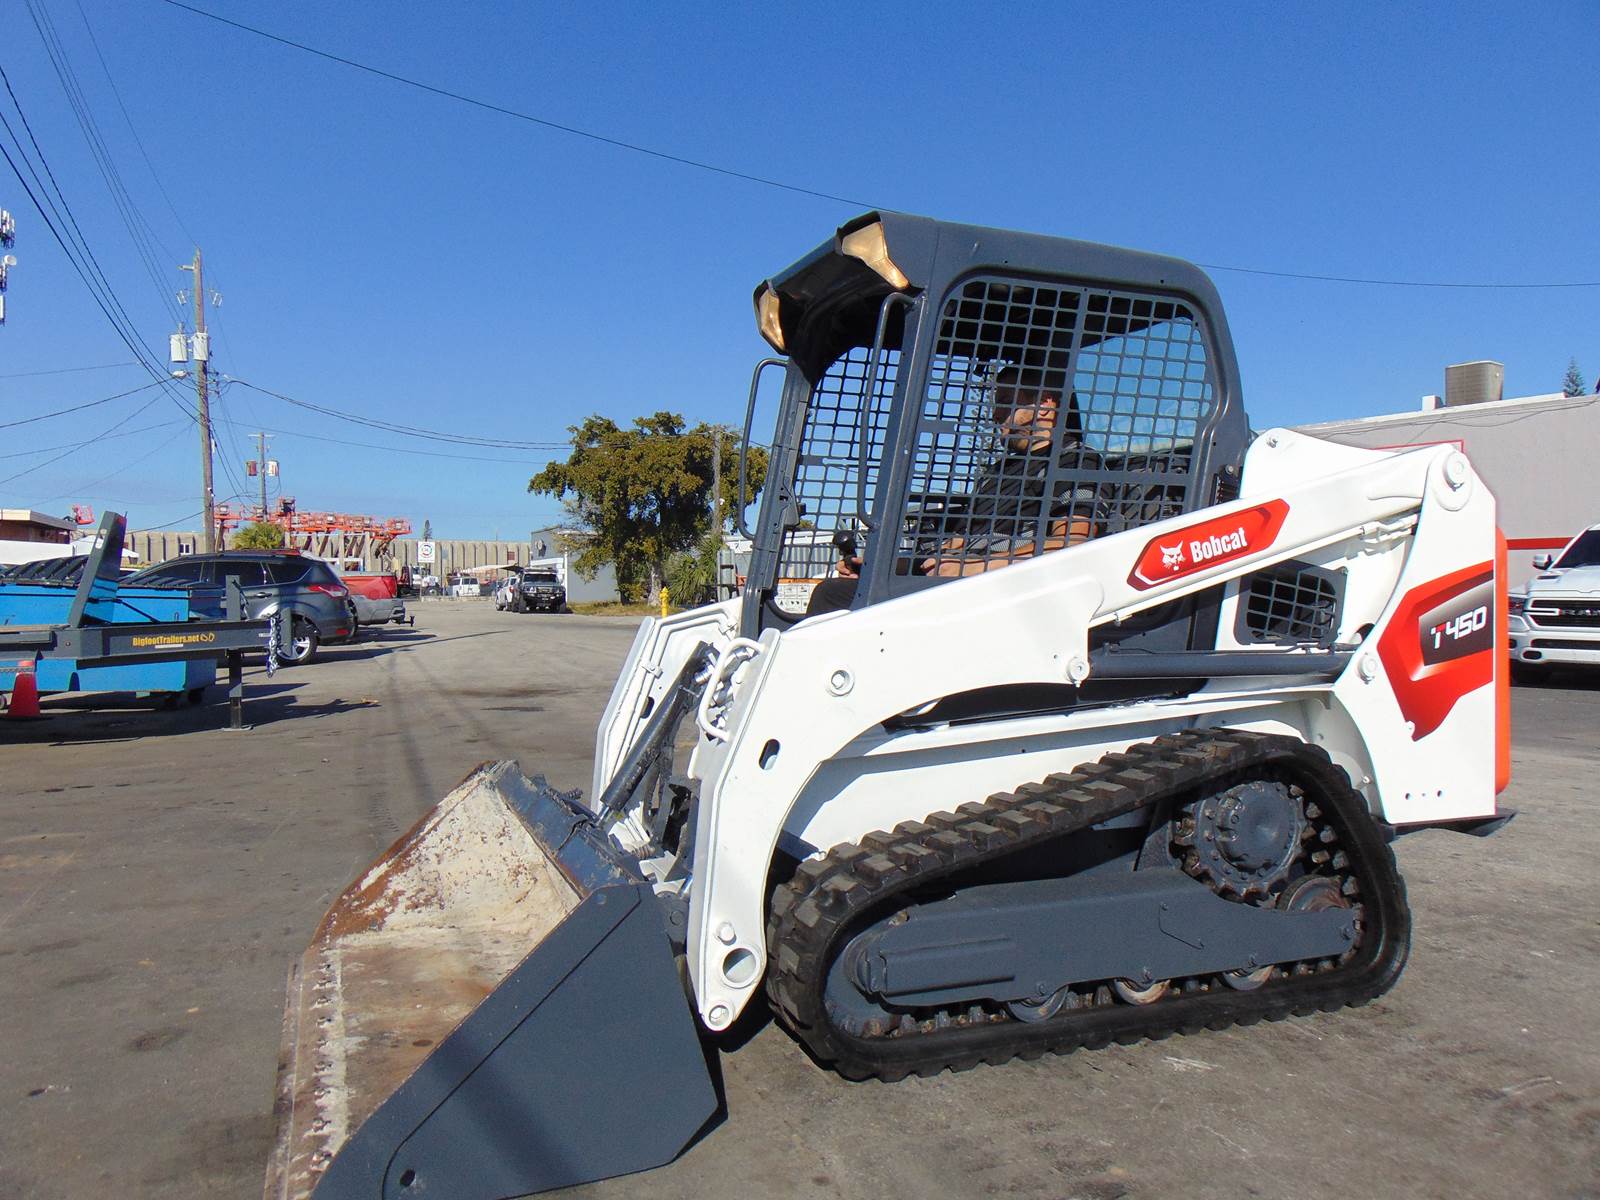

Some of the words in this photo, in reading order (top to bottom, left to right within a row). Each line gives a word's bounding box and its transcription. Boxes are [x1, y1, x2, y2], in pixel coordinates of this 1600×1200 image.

[1189, 527, 1248, 563] Bobcat
[132, 633, 201, 647] BigfootTrailers.net
[1430, 605, 1488, 649] T450
